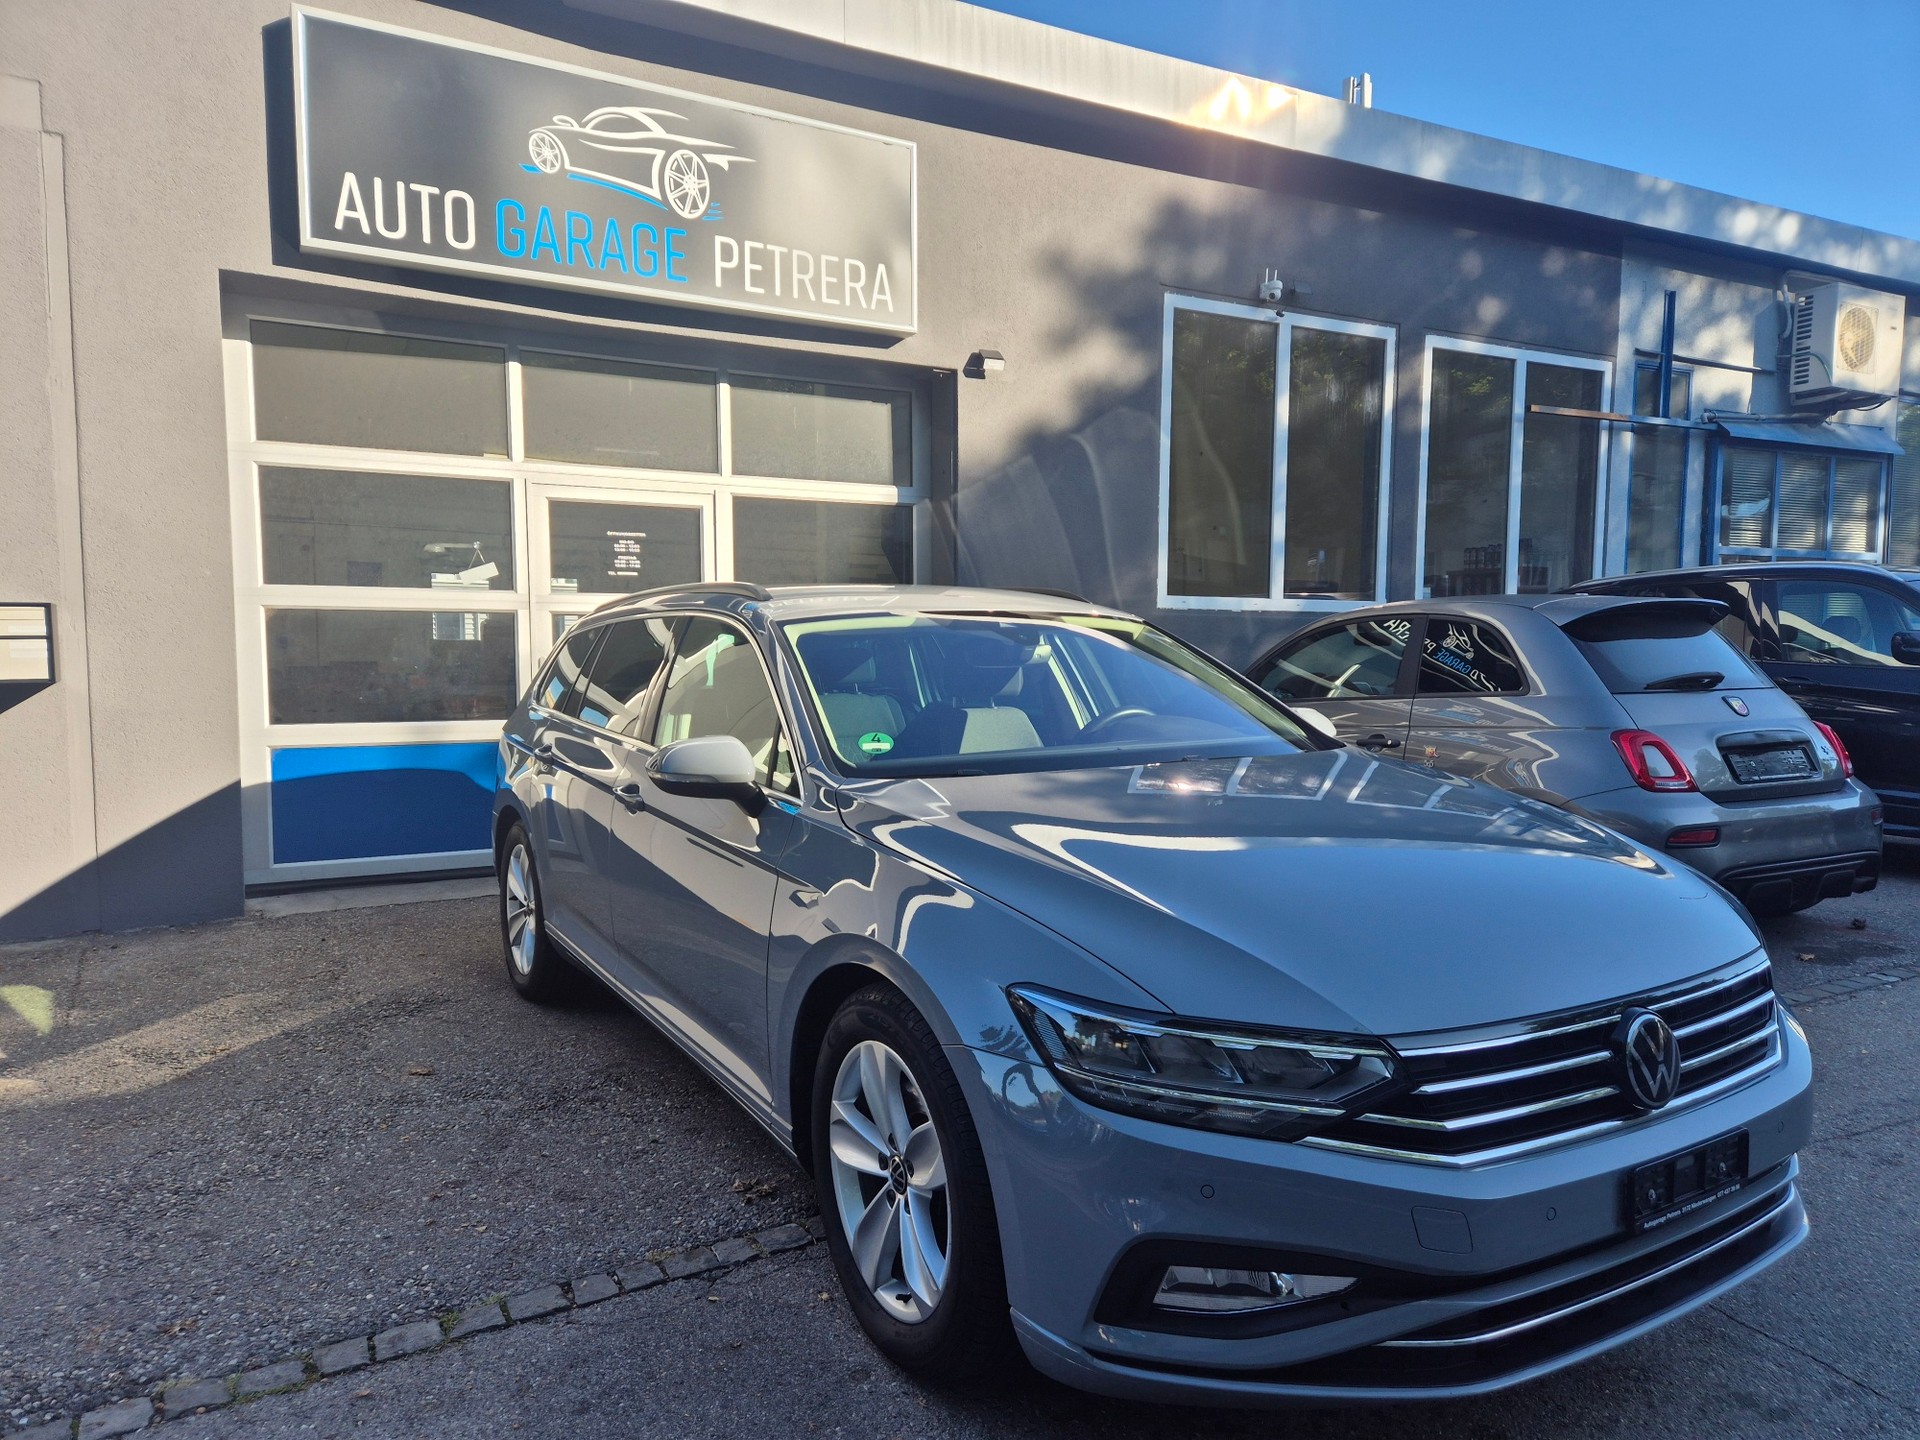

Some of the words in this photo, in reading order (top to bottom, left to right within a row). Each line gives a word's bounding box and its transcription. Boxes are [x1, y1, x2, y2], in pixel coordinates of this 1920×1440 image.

[334, 172, 476, 250] AUTO
[495, 199, 688, 284] GARAGE
[713, 235, 895, 313] PETRERA
[871, 733, 882, 743] 4
